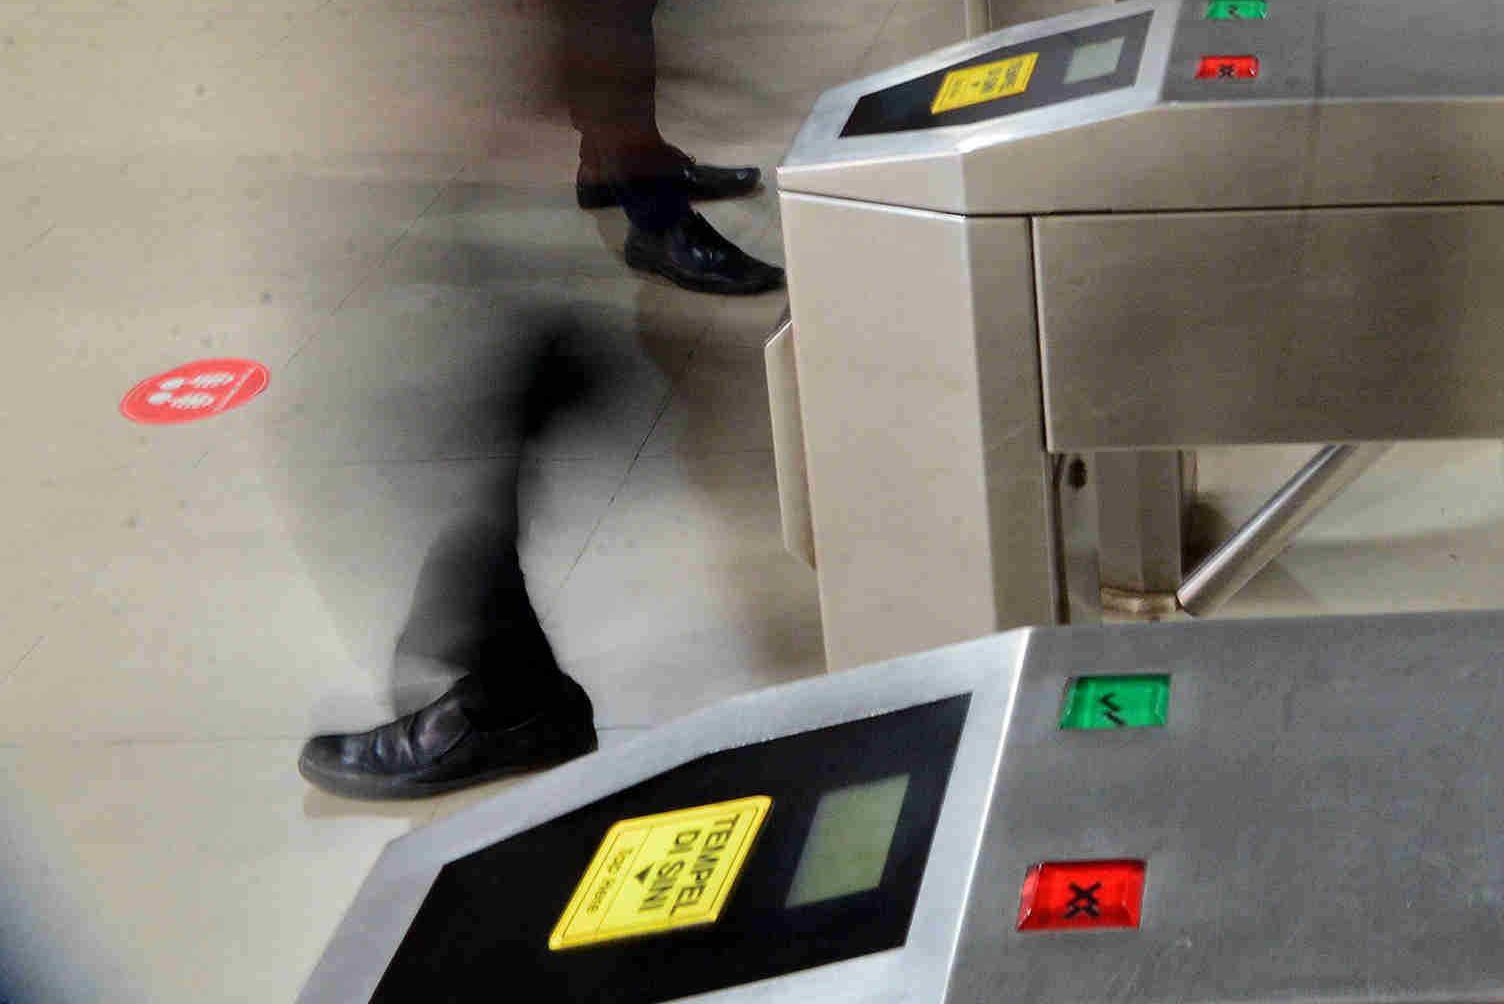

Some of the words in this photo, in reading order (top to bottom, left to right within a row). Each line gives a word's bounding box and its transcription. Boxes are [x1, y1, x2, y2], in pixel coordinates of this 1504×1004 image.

[668, 829, 702, 855] DI
[669, 813, 741, 917] TEMPEL
[637, 860, 685, 913] SINI
